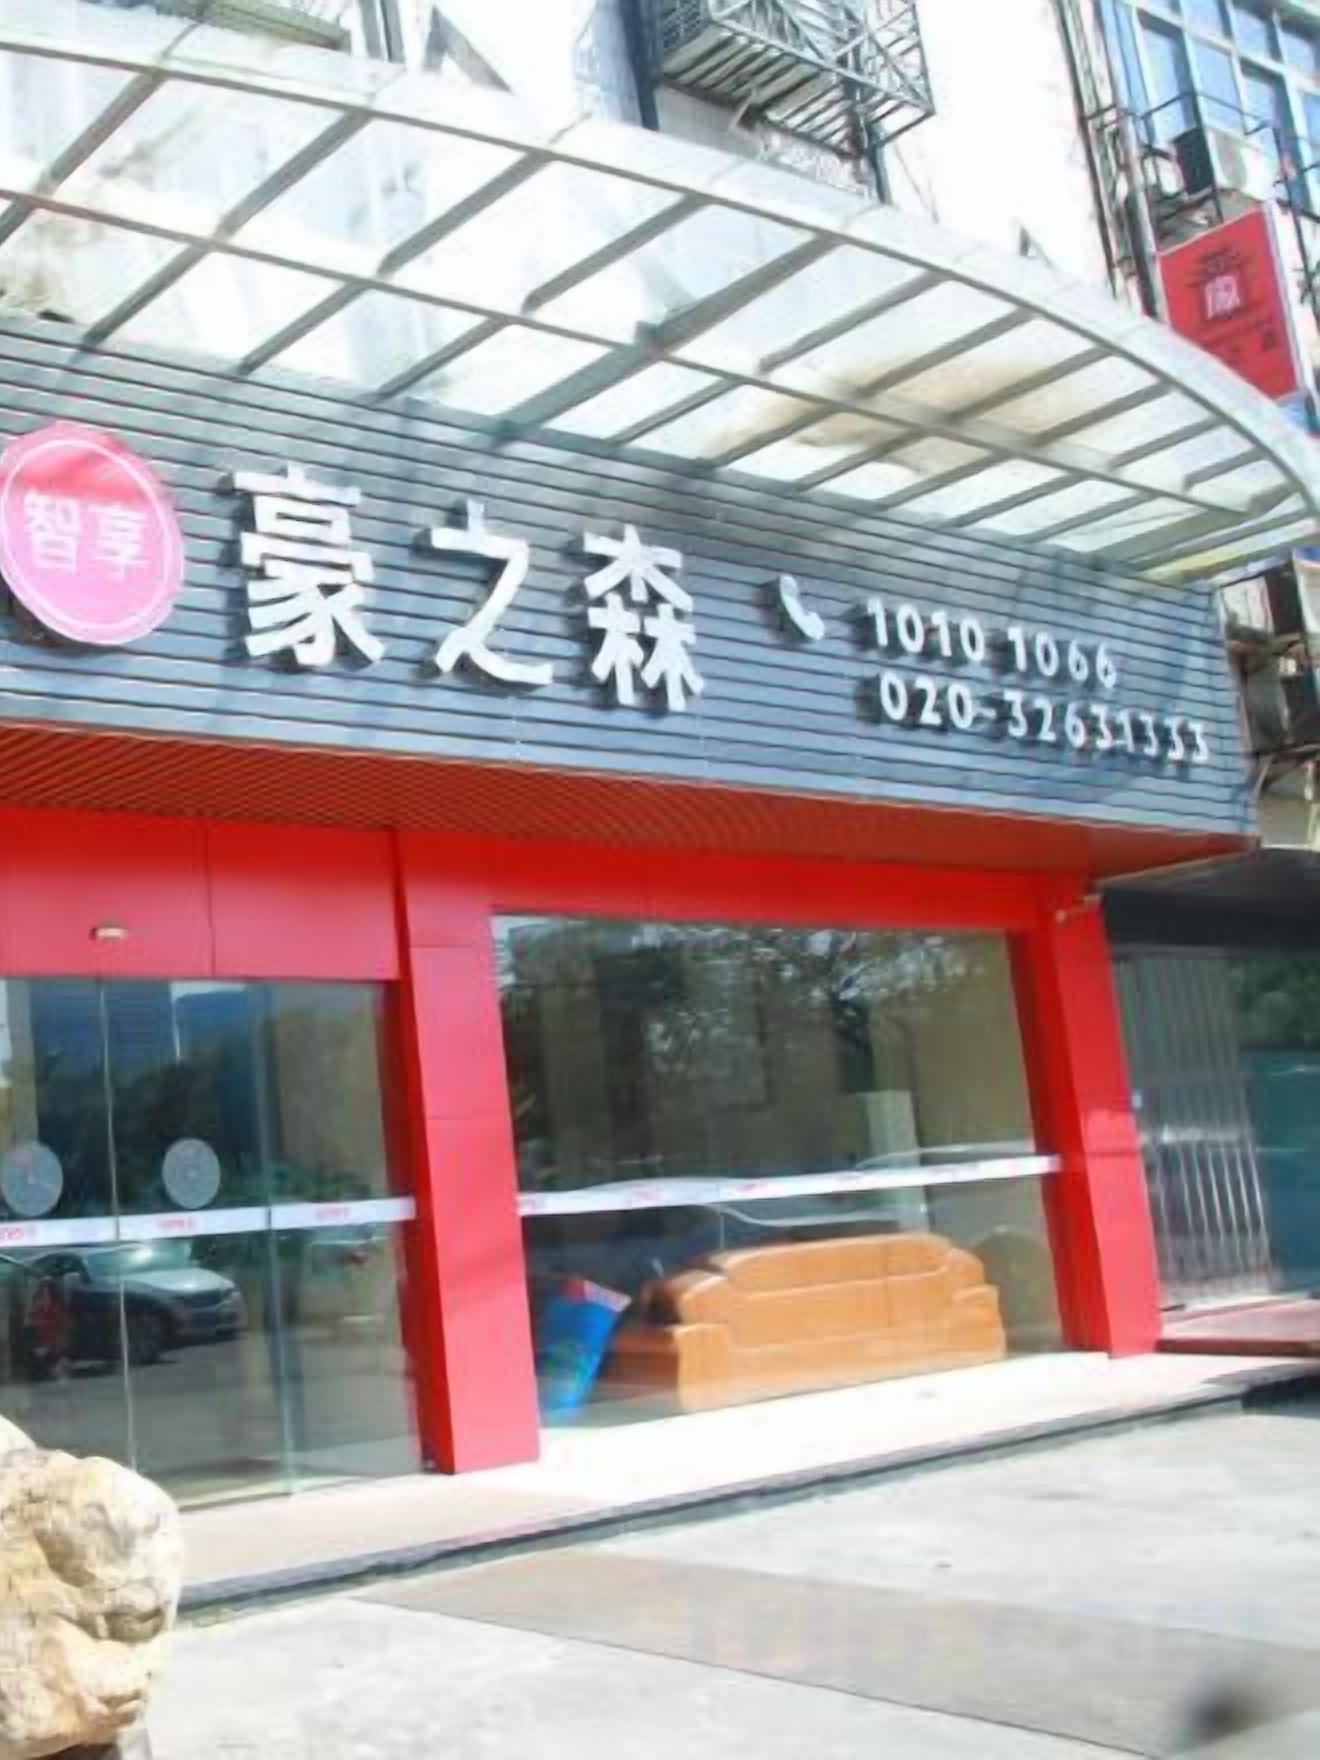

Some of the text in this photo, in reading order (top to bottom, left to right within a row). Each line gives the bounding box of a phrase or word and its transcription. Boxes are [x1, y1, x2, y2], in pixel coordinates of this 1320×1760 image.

[21, 488, 150, 582] 智享
[233, 462, 705, 713] 豪之森
[879, 670, 1210, 763] 020-32631333
